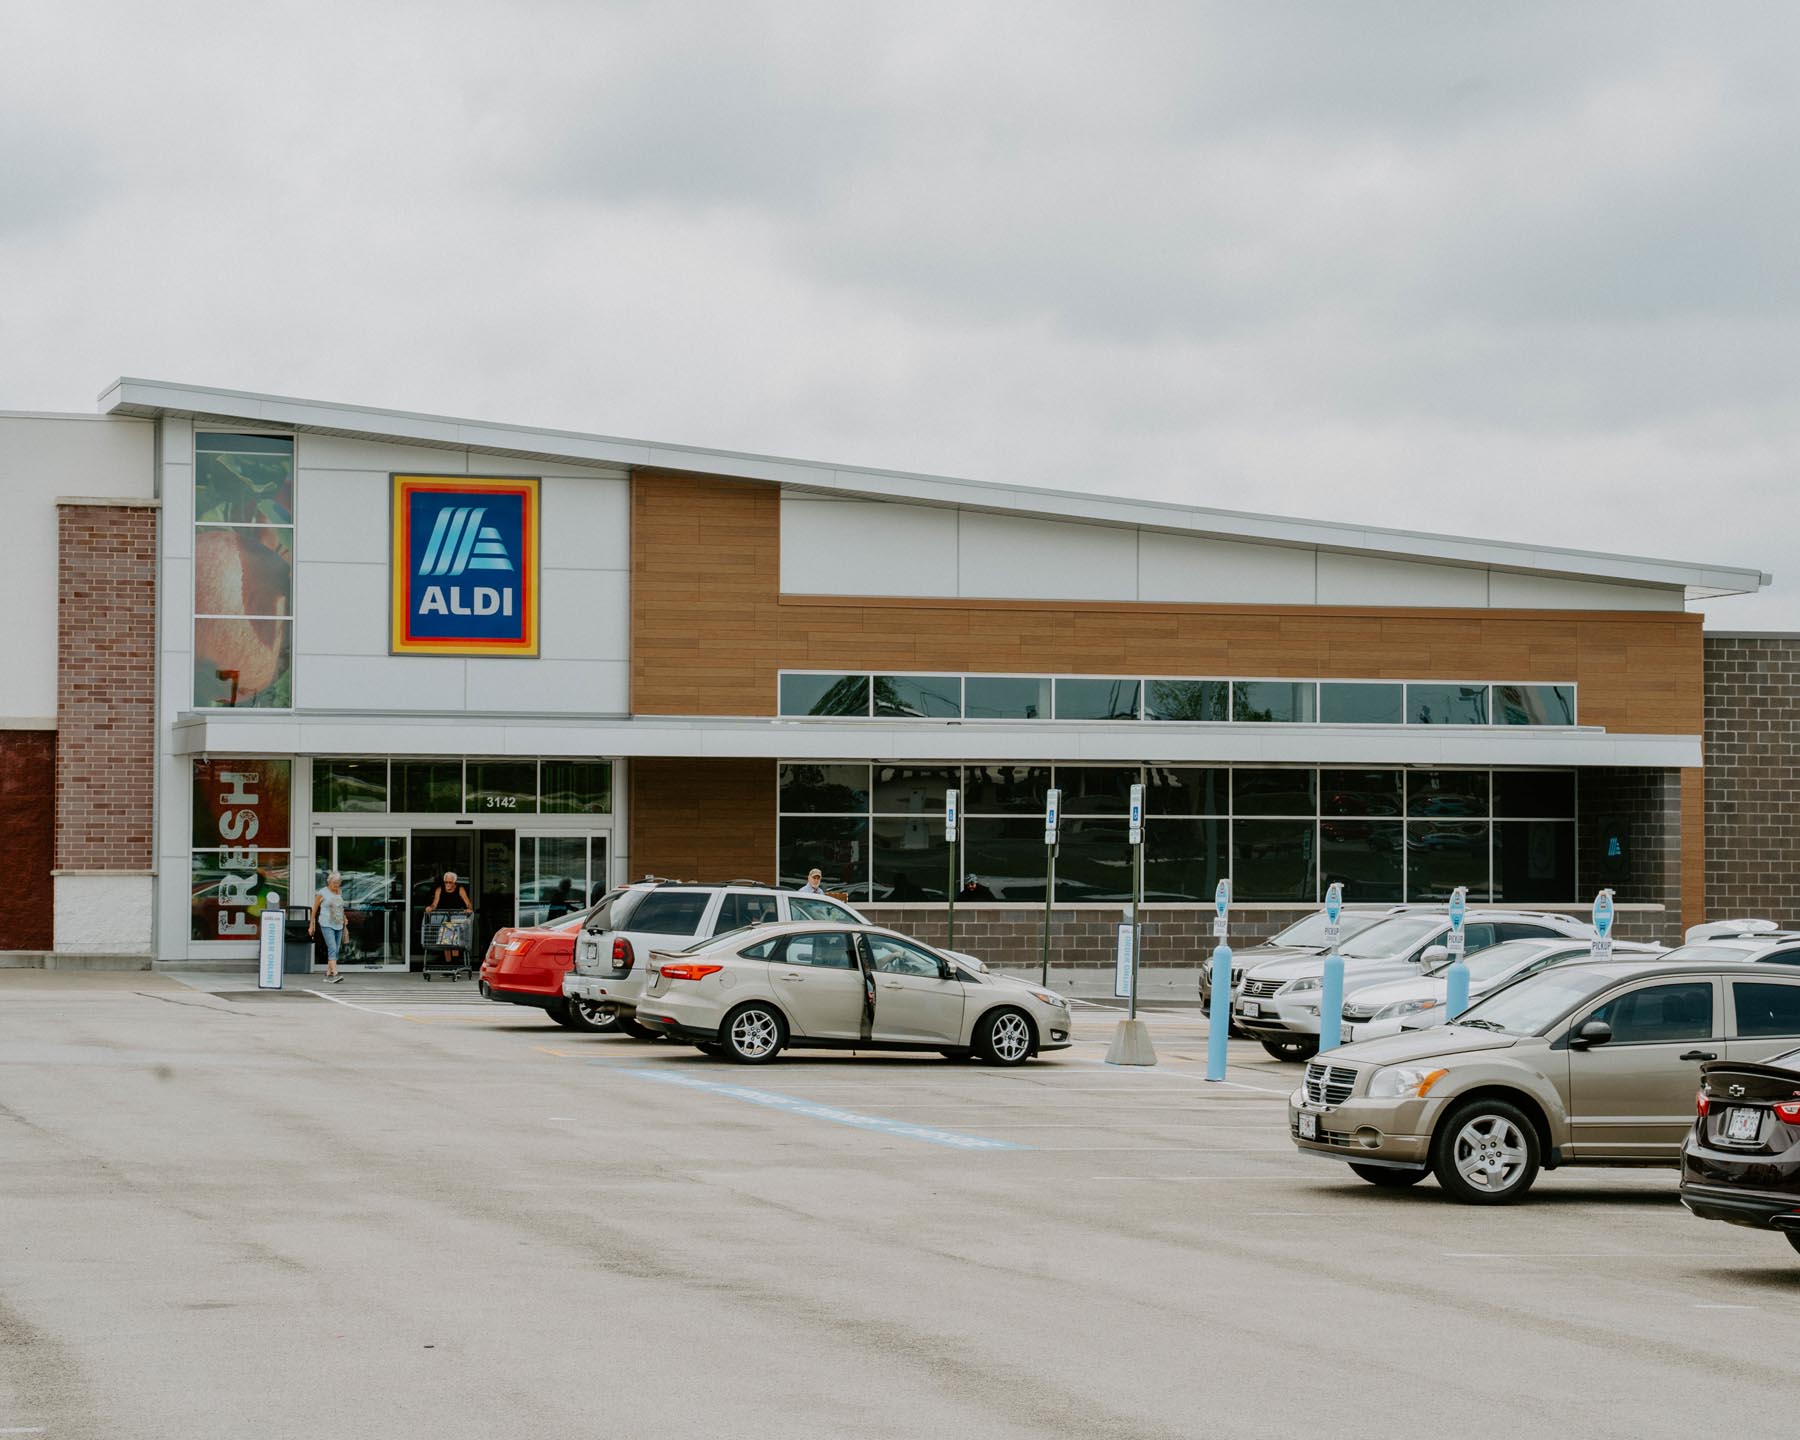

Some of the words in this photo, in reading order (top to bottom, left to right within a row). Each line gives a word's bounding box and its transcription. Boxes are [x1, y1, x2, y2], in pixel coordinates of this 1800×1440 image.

[418, 586, 513, 616] ALDI
[486, 796, 516, 808] 3142
[218, 772, 259, 935] FRESH
[1324, 927, 1339, 936] PICKUP
[1448, 934, 1463, 944] PICKUP
[1592, 941, 1611, 951] PICKUP
